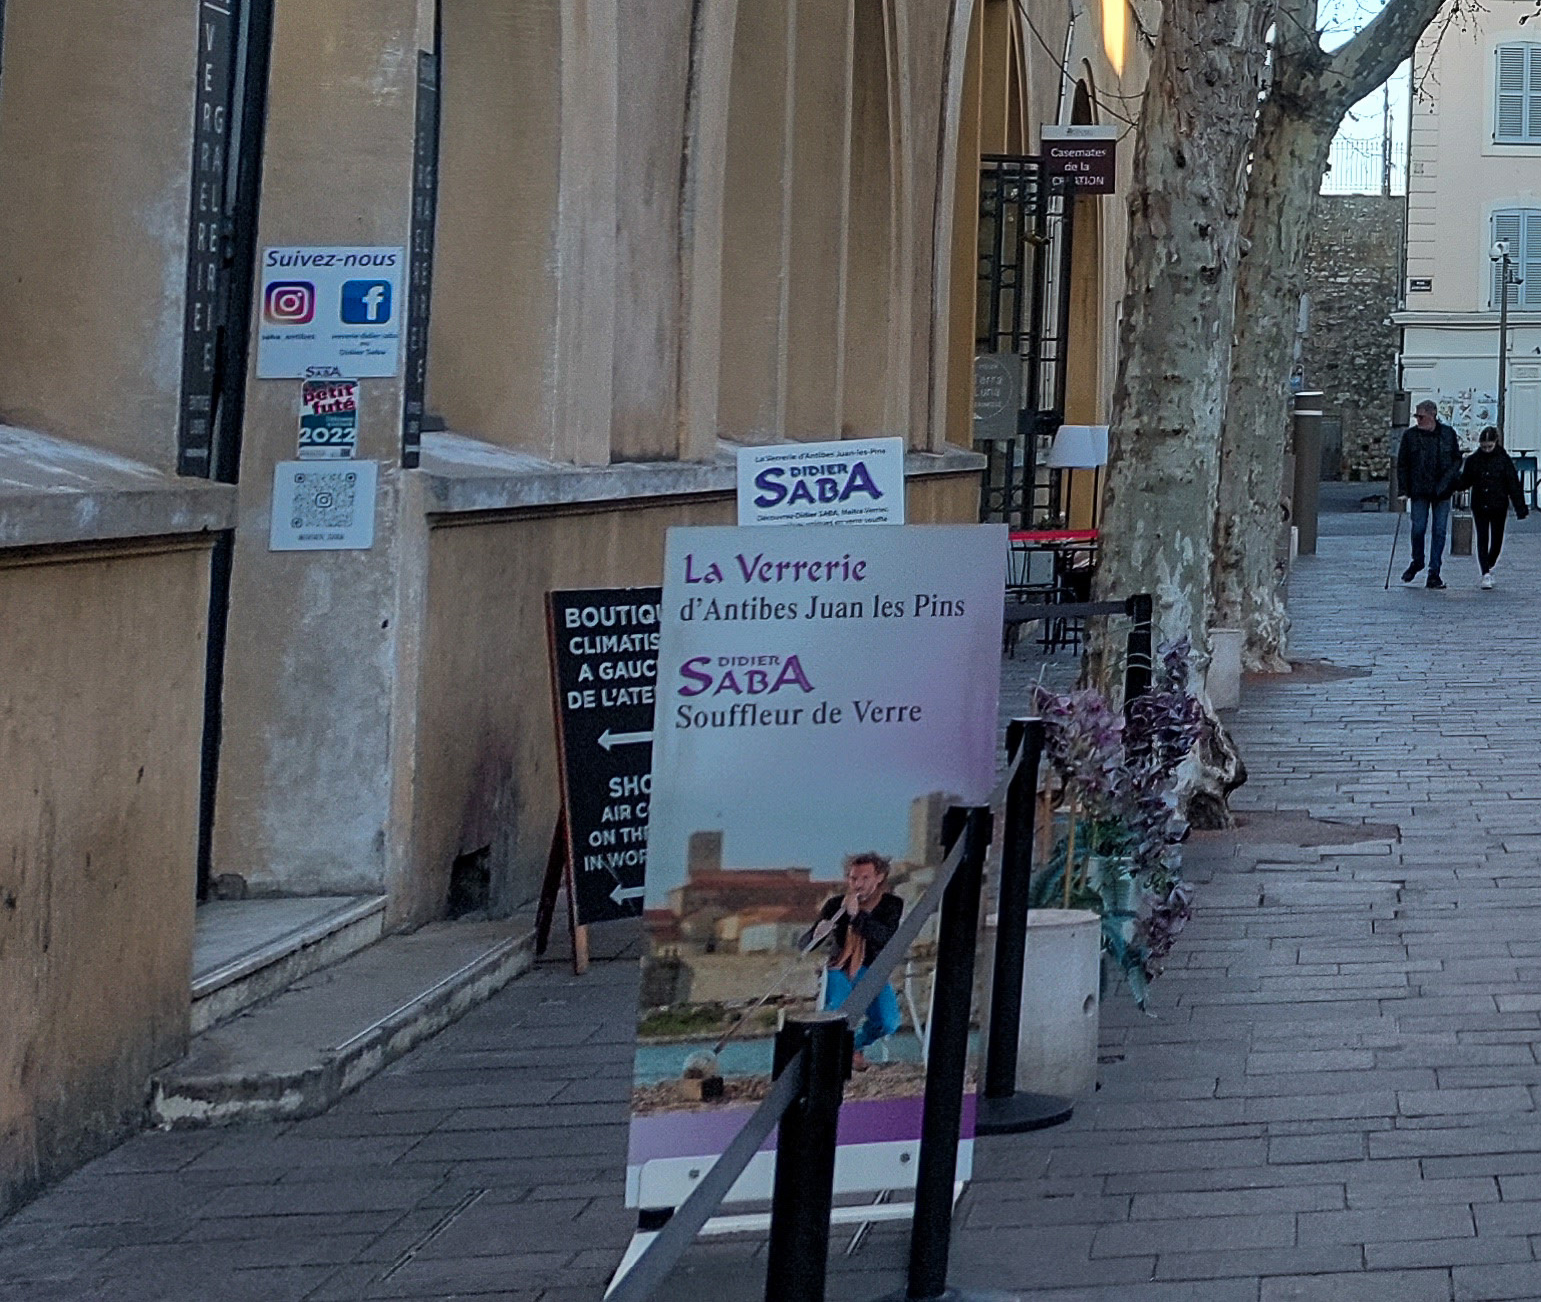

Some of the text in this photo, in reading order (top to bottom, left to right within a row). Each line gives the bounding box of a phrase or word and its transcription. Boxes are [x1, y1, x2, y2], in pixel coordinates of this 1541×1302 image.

[1051, 148, 1106, 157] Casemates
[1064, 162, 1090, 171] de la
[266, 250, 397, 267] Suivez-nous
[303, 384, 354, 406] petit
[312, 398, 356, 415] futé
[300, 427, 356, 443] 2022
[791, 464, 849, 478] DIDIER
[754, 461, 883, 508] SABA
[684, 553, 867, 584] La Verrerie
[680, 594, 965, 621] d'Antibes Juan les Pins
[718, 655, 780, 668] DIDIER
[578, 664, 593, 682] A
[677, 654, 815, 697] SABA
[567, 689, 596, 709] DE
[675, 700, 922, 729] Souffleur de Verre
[601, 802, 631, 823] AIR
[589, 829, 616, 847] ON
[584, 853, 602, 872] IN
